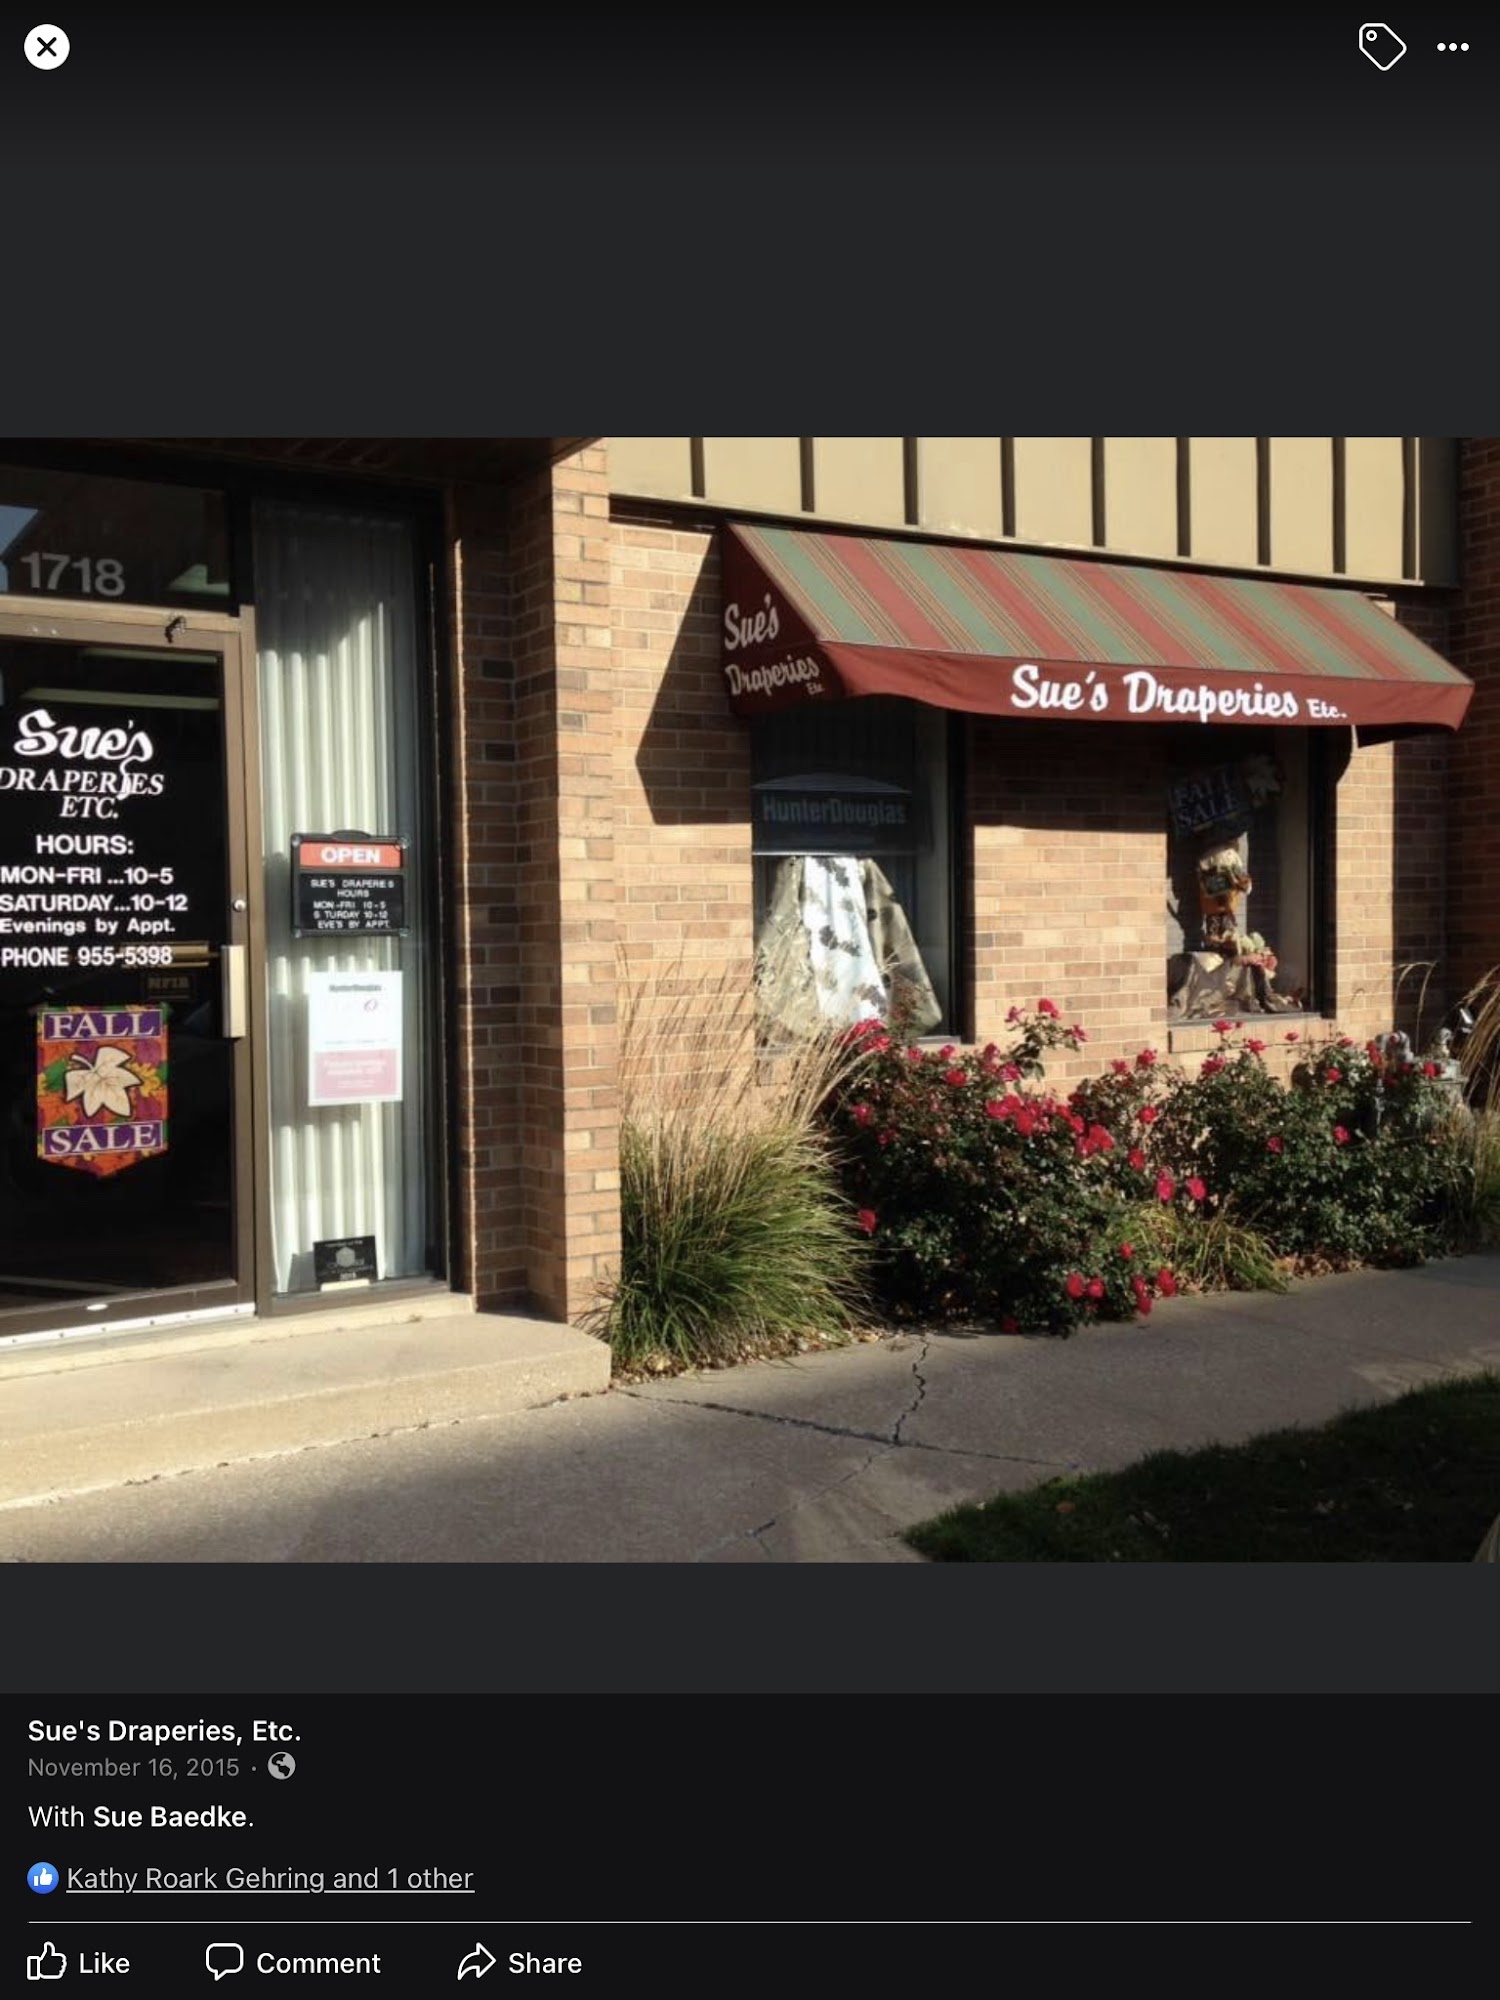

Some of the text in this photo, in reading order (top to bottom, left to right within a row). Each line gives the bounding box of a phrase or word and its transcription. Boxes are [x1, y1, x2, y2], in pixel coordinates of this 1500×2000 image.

[21, 552, 125, 596] 1718
[724, 593, 780, 650] Sue's
[725, 654, 820, 696] Draperies
[1011, 664, 1347, 723] Sue's Draperies Etc.
[13, 708, 153, 799] Sue's
[0, 767, 164, 796] DRAPERIES
[59, 796, 118, 818] ETC.
[36, 834, 134, 855] HOURS:
[320, 847, 380, 863] OPEN
[0, 866, 101, 885] MON-FRI
[310, 879, 335, 888] SUE'S
[337, 889, 369, 898] HOURS
[313, 901, 355, 909] MON-FRI
[0, 917, 175, 936] Evenings by Appt.
[317, 920, 343, 929] EVE'S
[348, 920, 359, 929] BY
[1, 946, 173, 967] PHONE 955-5398
[50, 1013, 154, 1039] FALL
[50, 1124, 156, 1153] SALE
